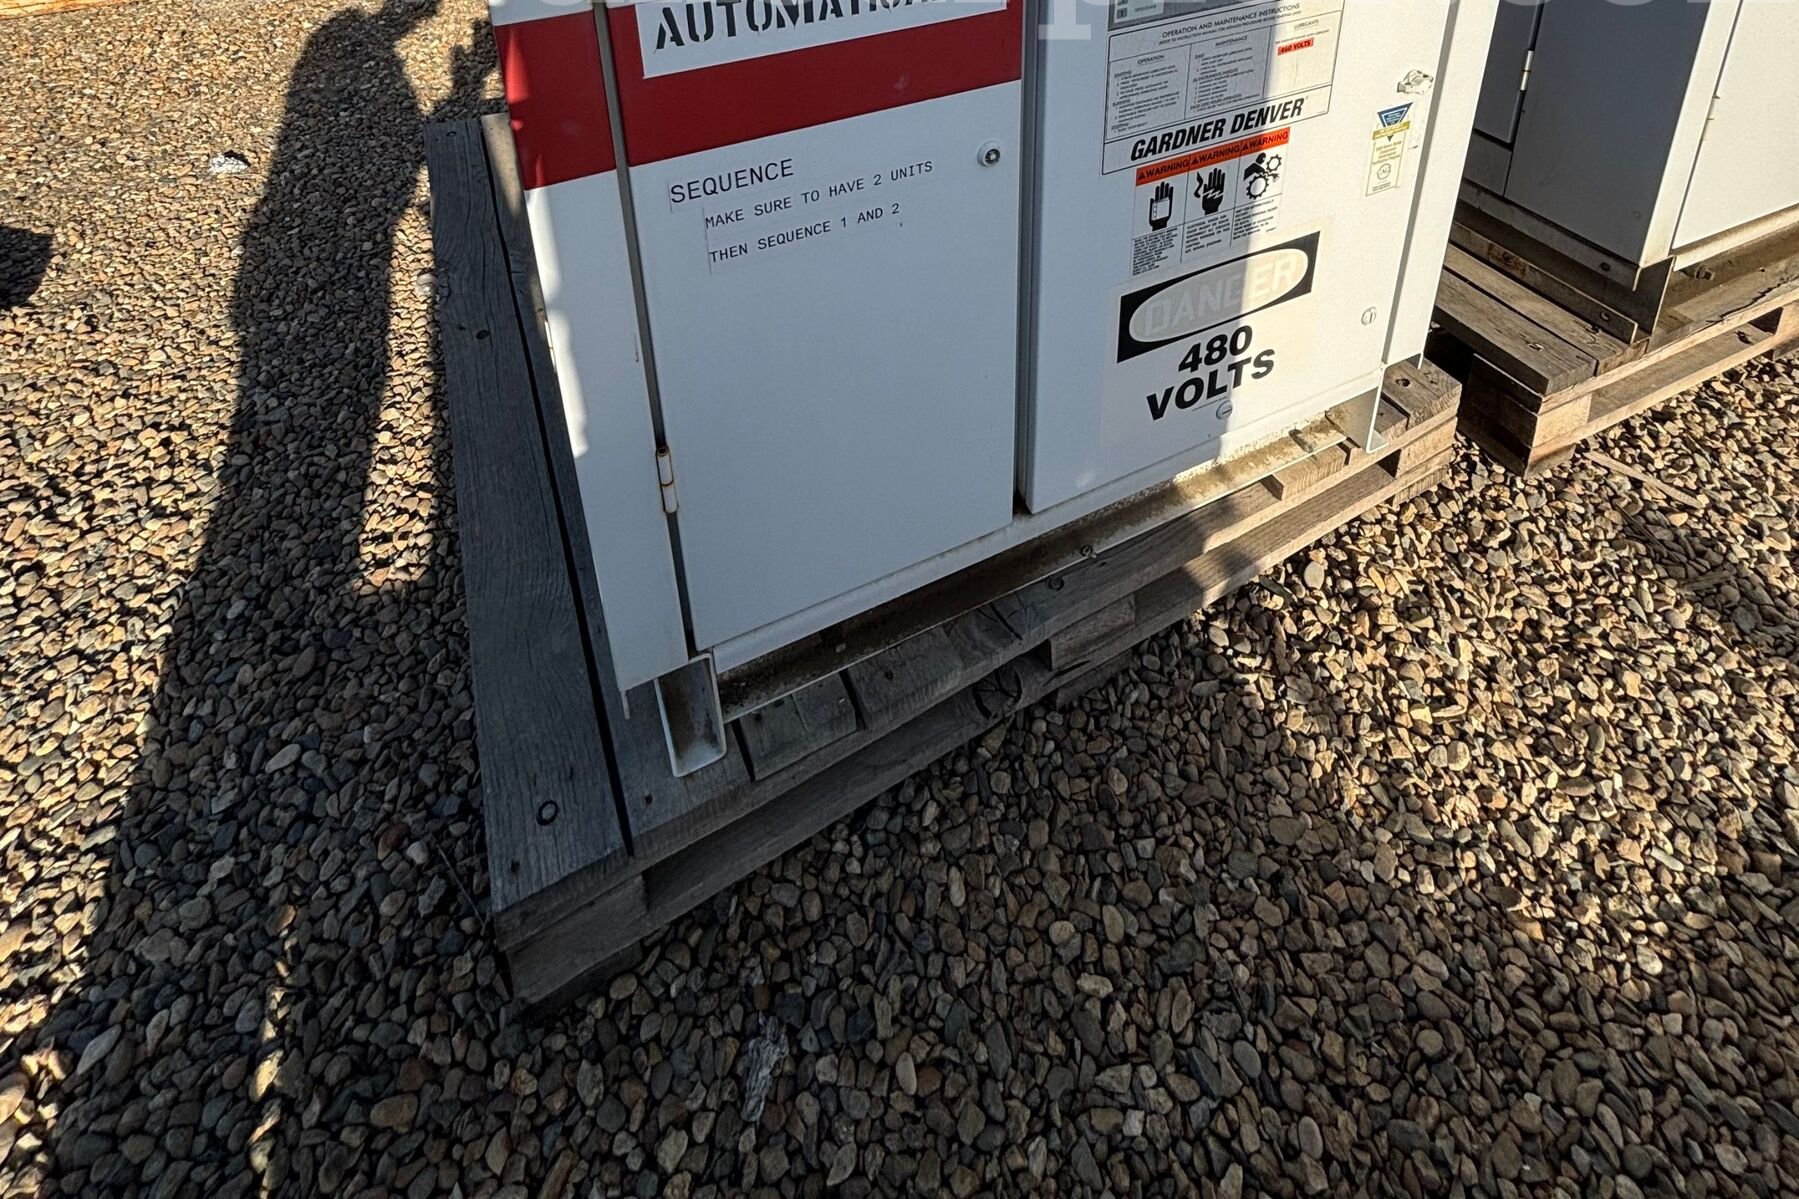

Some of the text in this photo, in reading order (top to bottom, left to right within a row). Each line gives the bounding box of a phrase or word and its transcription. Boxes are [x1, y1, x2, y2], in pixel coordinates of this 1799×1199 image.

[1162, 25, 1197, 38] OPERATION
[1198, 21, 1213, 30] AND
[1214, 11, 1257, 27] MAINTENANCE
[1258, 3, 1300, 17] INSTRUCTIONS
[1130, 118, 1226, 161] GARDNER
[1230, 98, 1305, 134] DENVER
[1199, 144, 1241, 163] WARNING
[1249, 131, 1288, 149] WARNING
[671, 158, 794, 204] SEQUENCE
[1146, 158, 1189, 178] WARNING
[705, 160, 933, 230] MAKE SURE TO HAVE 2 UNITS
[709, 202, 900, 263] THEN SEQUENCE 1 AND 2
[1145, 254, 1296, 336] DANGER
[1178, 325, 1253, 373] 480
[1146, 348, 1275, 421] VOLTS
